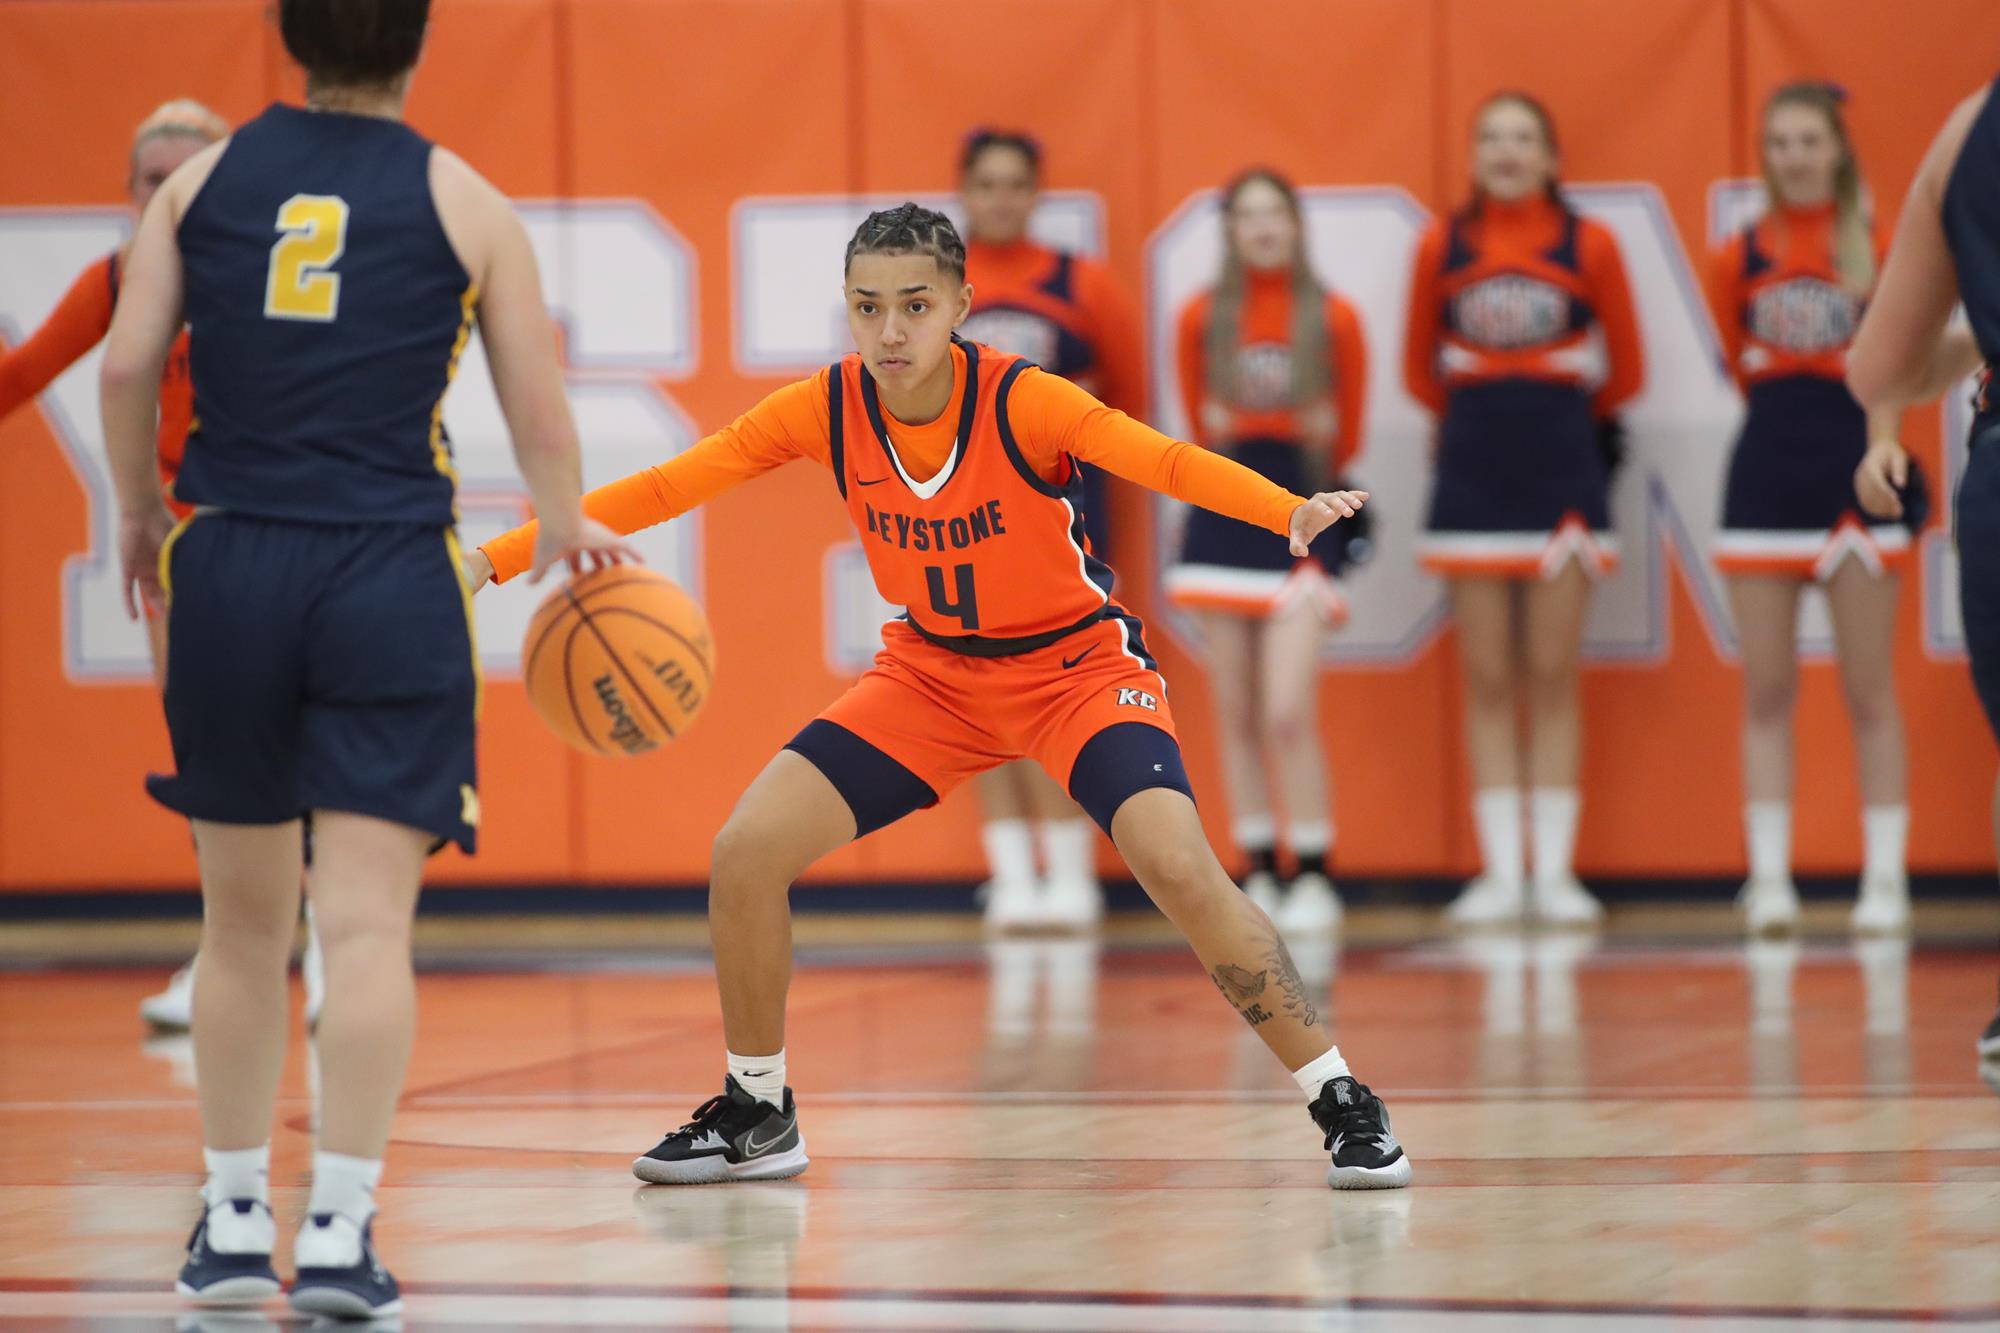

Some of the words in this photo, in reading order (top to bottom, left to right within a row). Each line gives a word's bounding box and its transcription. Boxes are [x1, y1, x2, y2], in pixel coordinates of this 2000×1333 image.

[263, 193, 350, 324] 2
[924, 562, 980, 630] 4
[1116, 687, 1158, 712] KC
